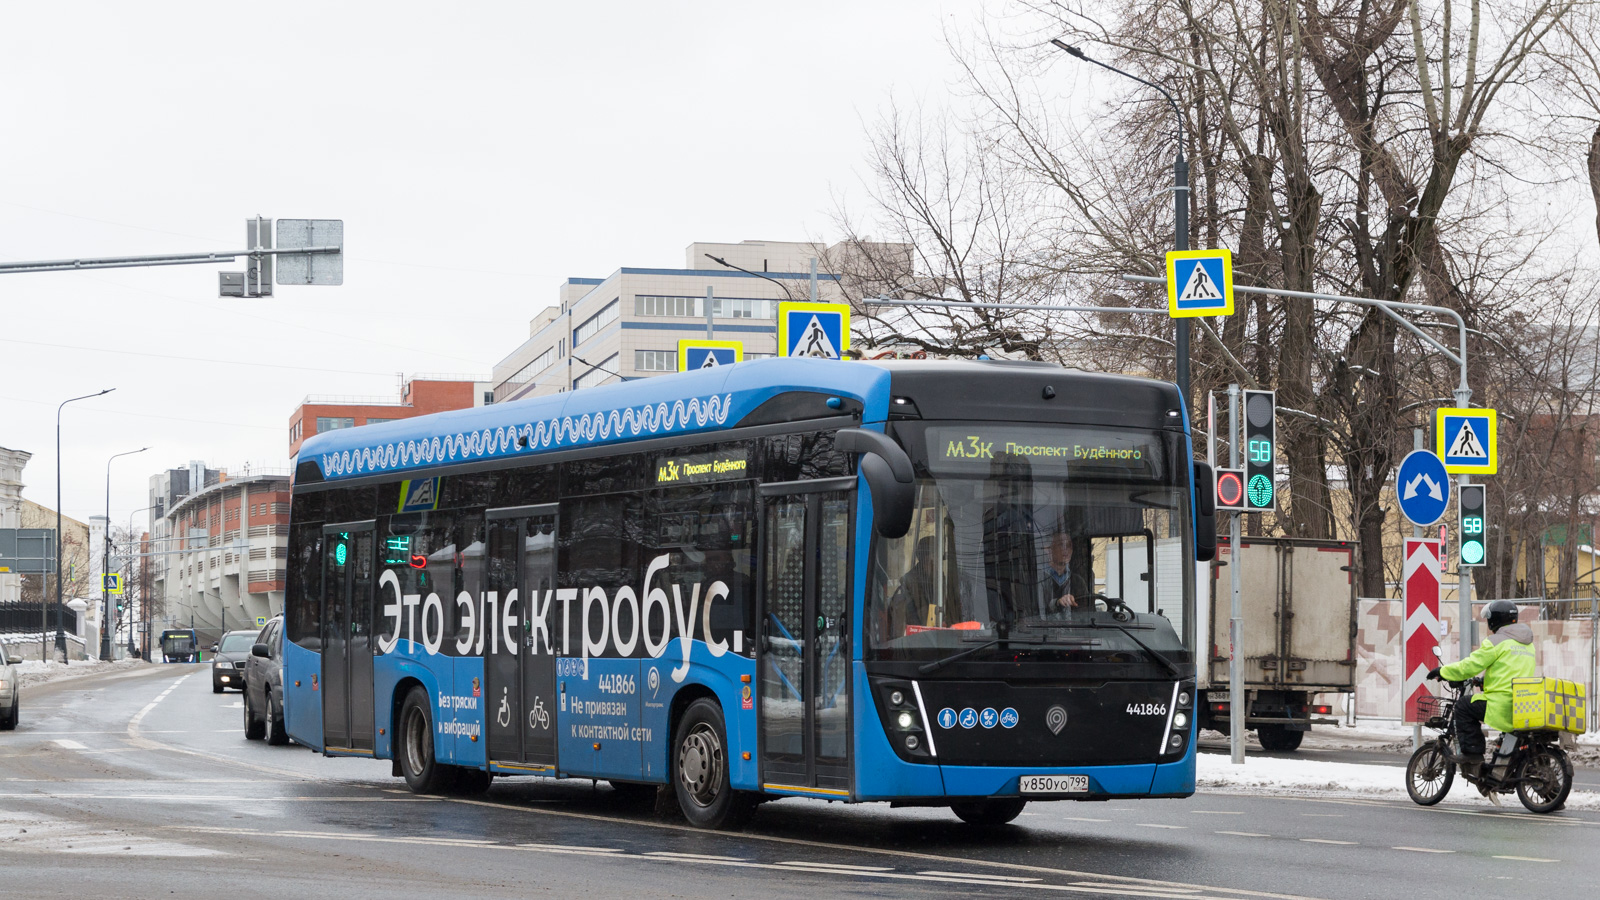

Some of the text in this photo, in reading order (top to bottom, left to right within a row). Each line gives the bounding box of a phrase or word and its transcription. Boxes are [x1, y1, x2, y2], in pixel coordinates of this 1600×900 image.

[1005, 442, 1068, 456] Проспект
[1074, 445, 1142, 460] Будённого
[1249, 440, 1271, 462] 58
[683, 463, 713, 476] Проспект
[713, 459, 747, 473] Будённого
[1463, 517, 1482, 533] 58
[378, 552, 743, 683] Это электробус.
[598, 674, 636, 694] 441866
[451, 695, 477, 712] тряски
[571, 696, 627, 719] Не привязан
[1126, 703, 1167, 716] 441866
[444, 717, 480, 738] вибраций
[571, 722, 652, 742] к контактной сети
[1069, 777, 1086, 787] 799
